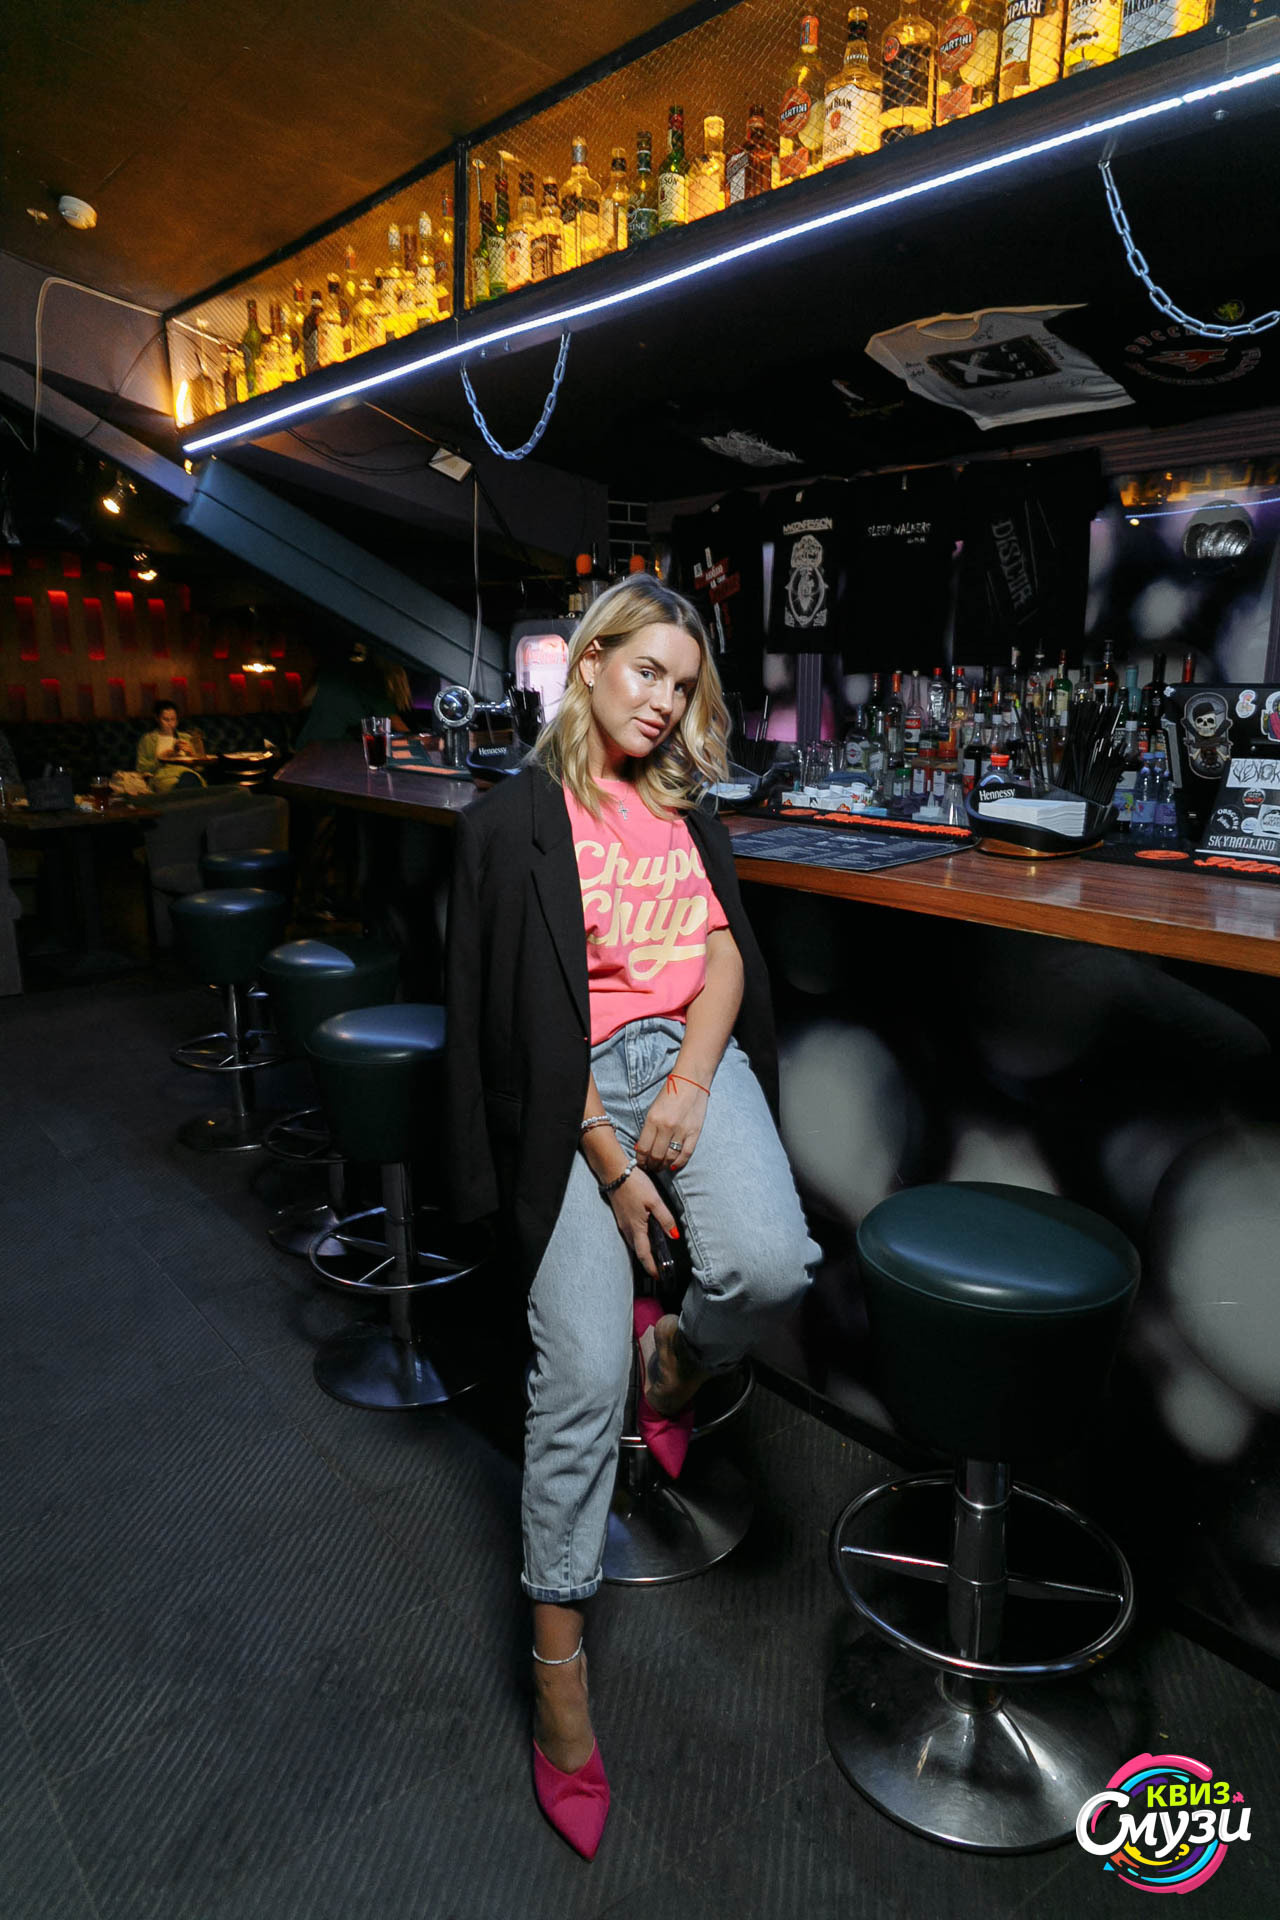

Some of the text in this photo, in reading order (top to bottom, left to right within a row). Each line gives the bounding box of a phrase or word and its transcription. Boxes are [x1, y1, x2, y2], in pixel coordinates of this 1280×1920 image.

[940, 33, 973, 54] MARTINI
[780, 102, 807, 121] MARTINI
[979, 788, 1016, 801] Hennessy
[582, 888, 709, 980] Chup
